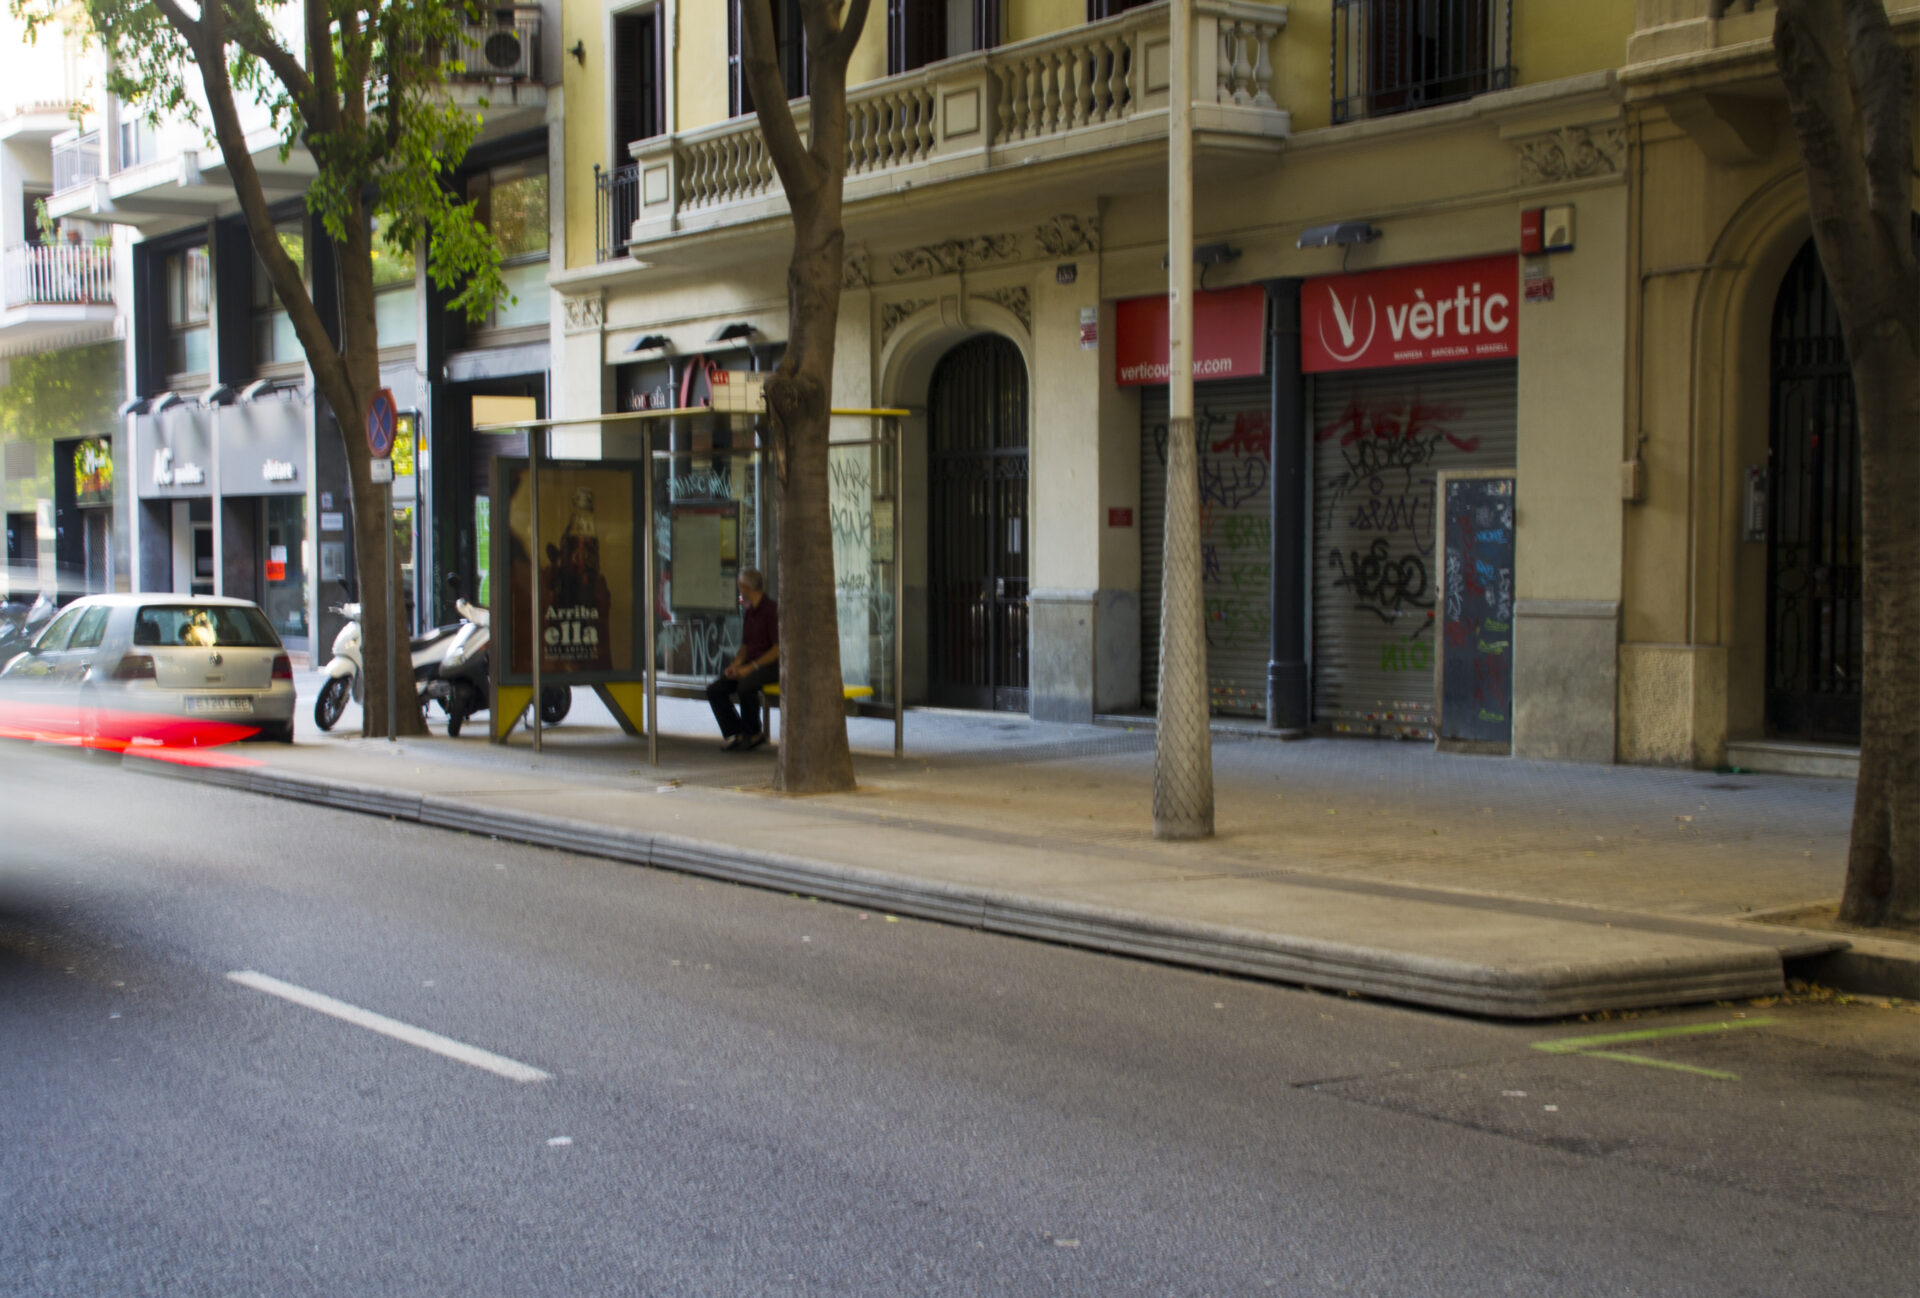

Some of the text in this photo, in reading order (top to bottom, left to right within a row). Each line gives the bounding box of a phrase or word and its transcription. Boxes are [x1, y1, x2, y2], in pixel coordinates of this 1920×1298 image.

[1386, 282, 1509, 342] vèrtic
[1431, 345, 1469, 358] BARCELONA
[1476, 342, 1509, 355] SABADELL
[545, 604, 599, 620] Arriba
[544, 621, 599, 646] ella
